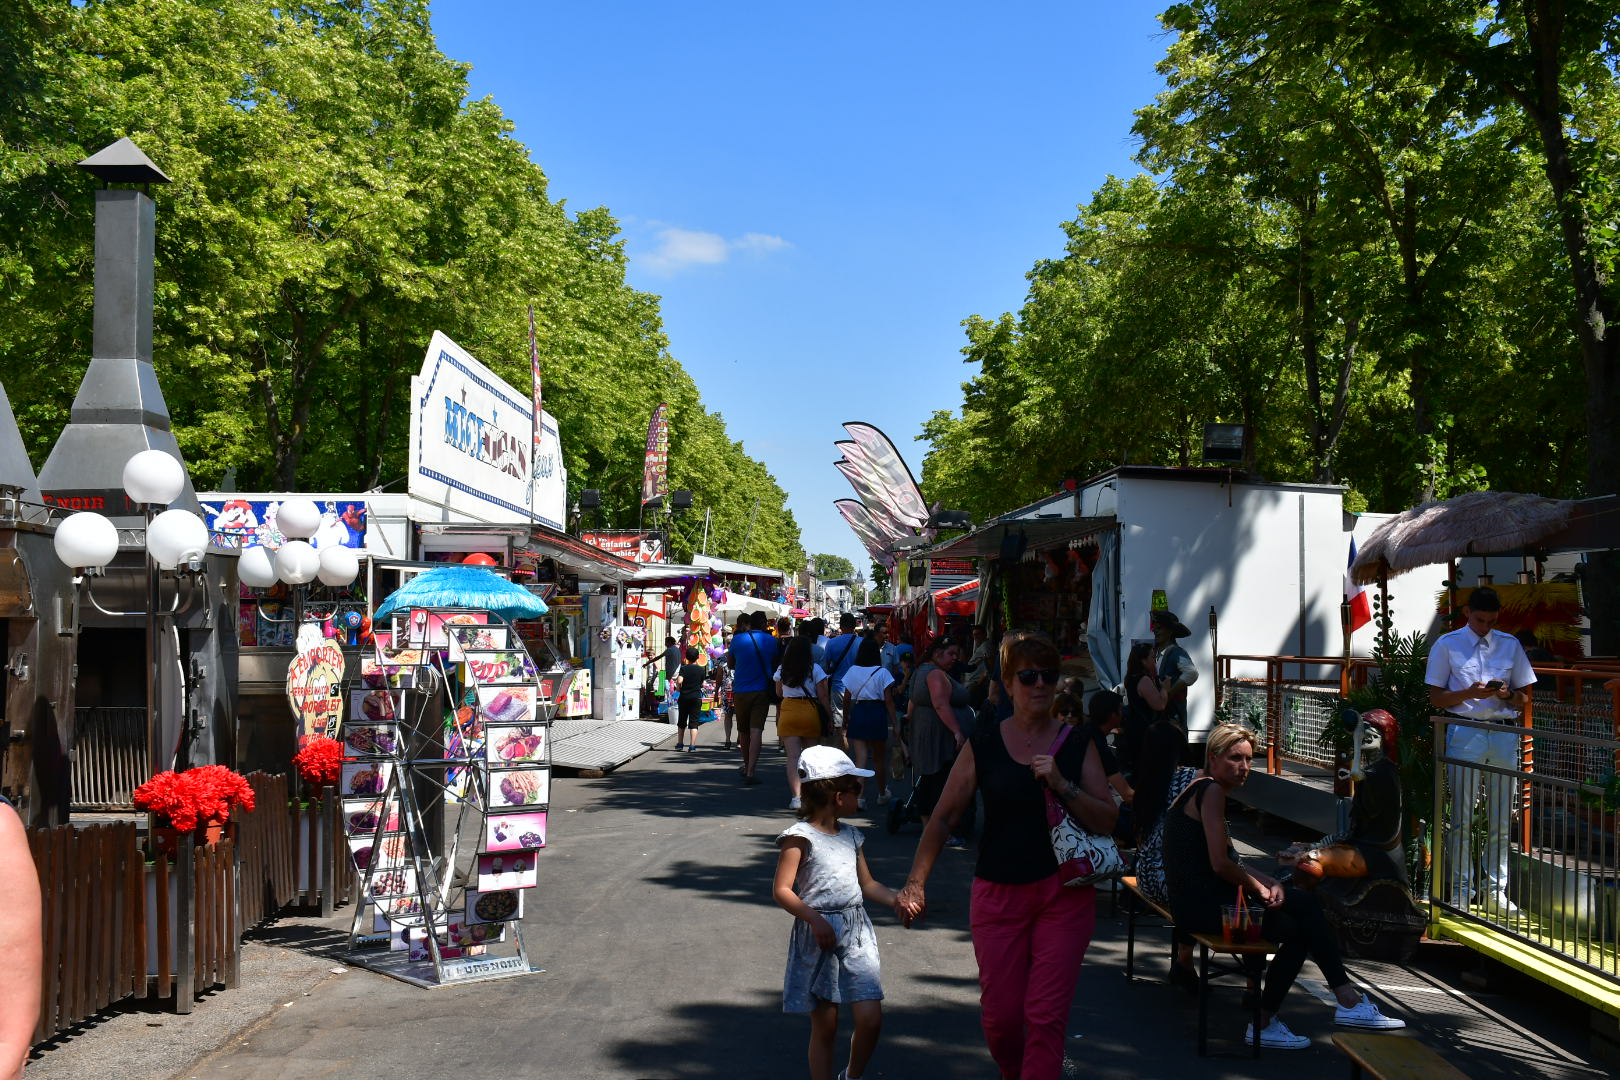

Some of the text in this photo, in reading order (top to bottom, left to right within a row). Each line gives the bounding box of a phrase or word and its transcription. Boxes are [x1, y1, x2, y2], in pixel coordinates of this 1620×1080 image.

[656, 410, 667, 492] MICHIGAN
[55, 496, 105, 509] NOIR
[298, 647, 343, 673] EMPORTER
